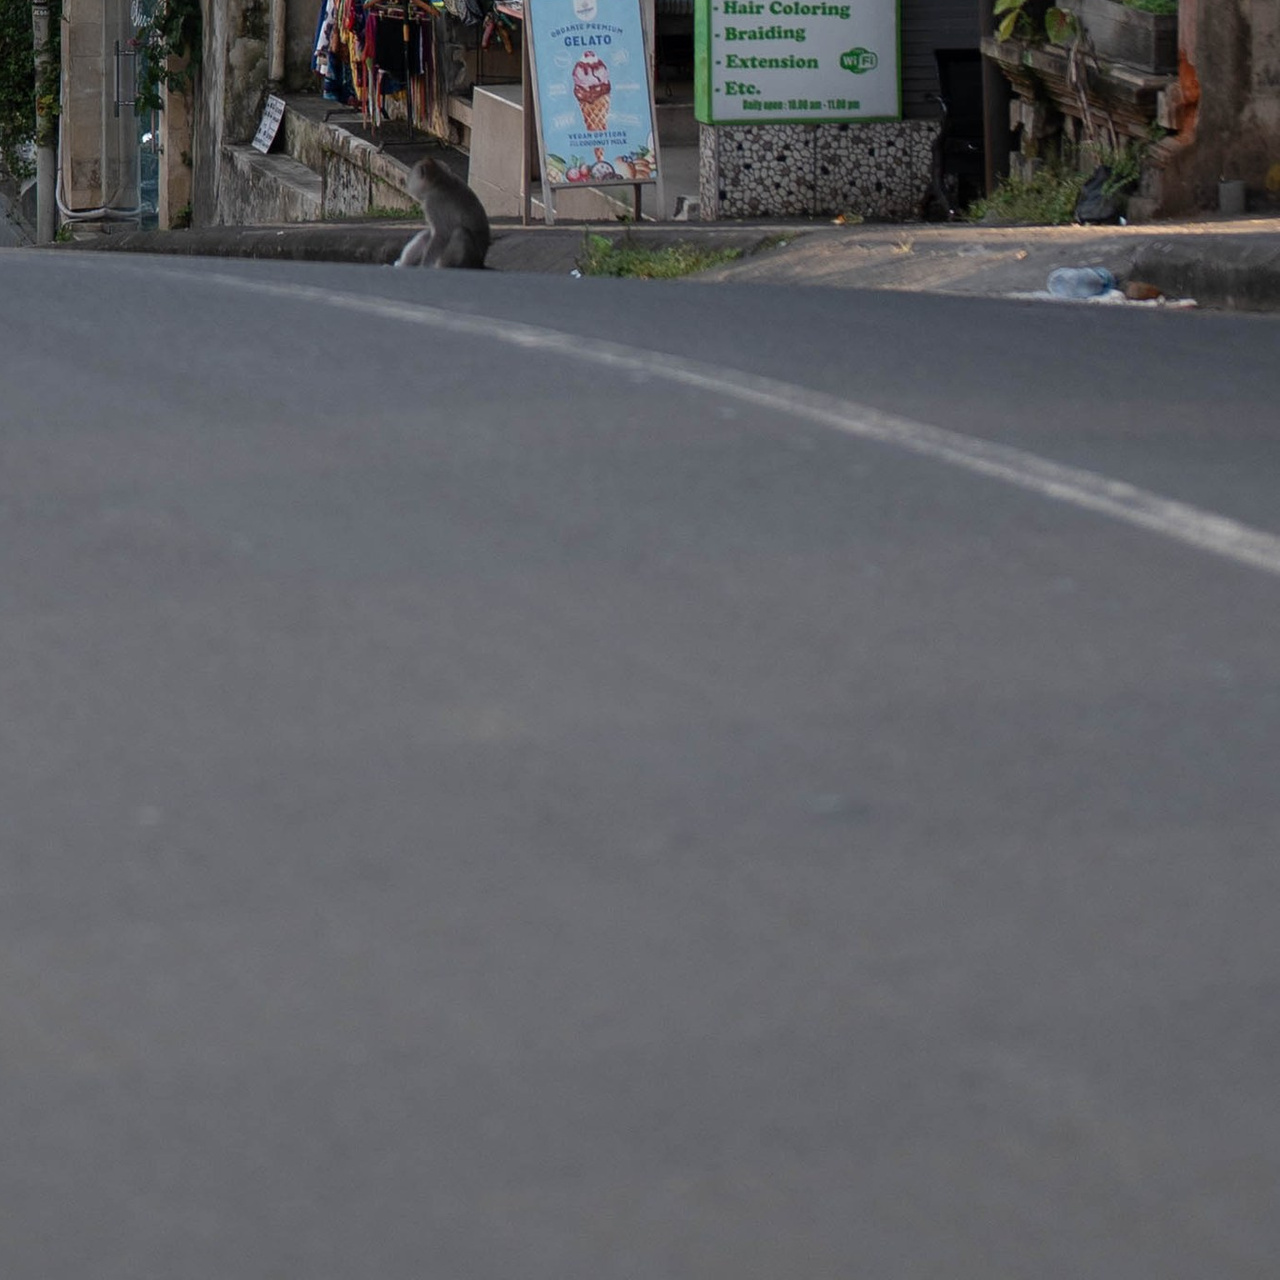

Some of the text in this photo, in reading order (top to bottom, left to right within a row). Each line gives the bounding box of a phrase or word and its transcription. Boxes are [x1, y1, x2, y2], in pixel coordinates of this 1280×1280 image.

[723, 0, 851, 20] Hair Coloring
[550, 22, 623, 38] ORGANIC PREMIUM
[725, 25, 806, 42] Braiding
[564, 34, 612, 47] GELATO
[726, 54, 819, 69] Extension
[725, 81, 762, 96] Etc.
[568, 130, 627, 140] VEGAN OPTIONS
